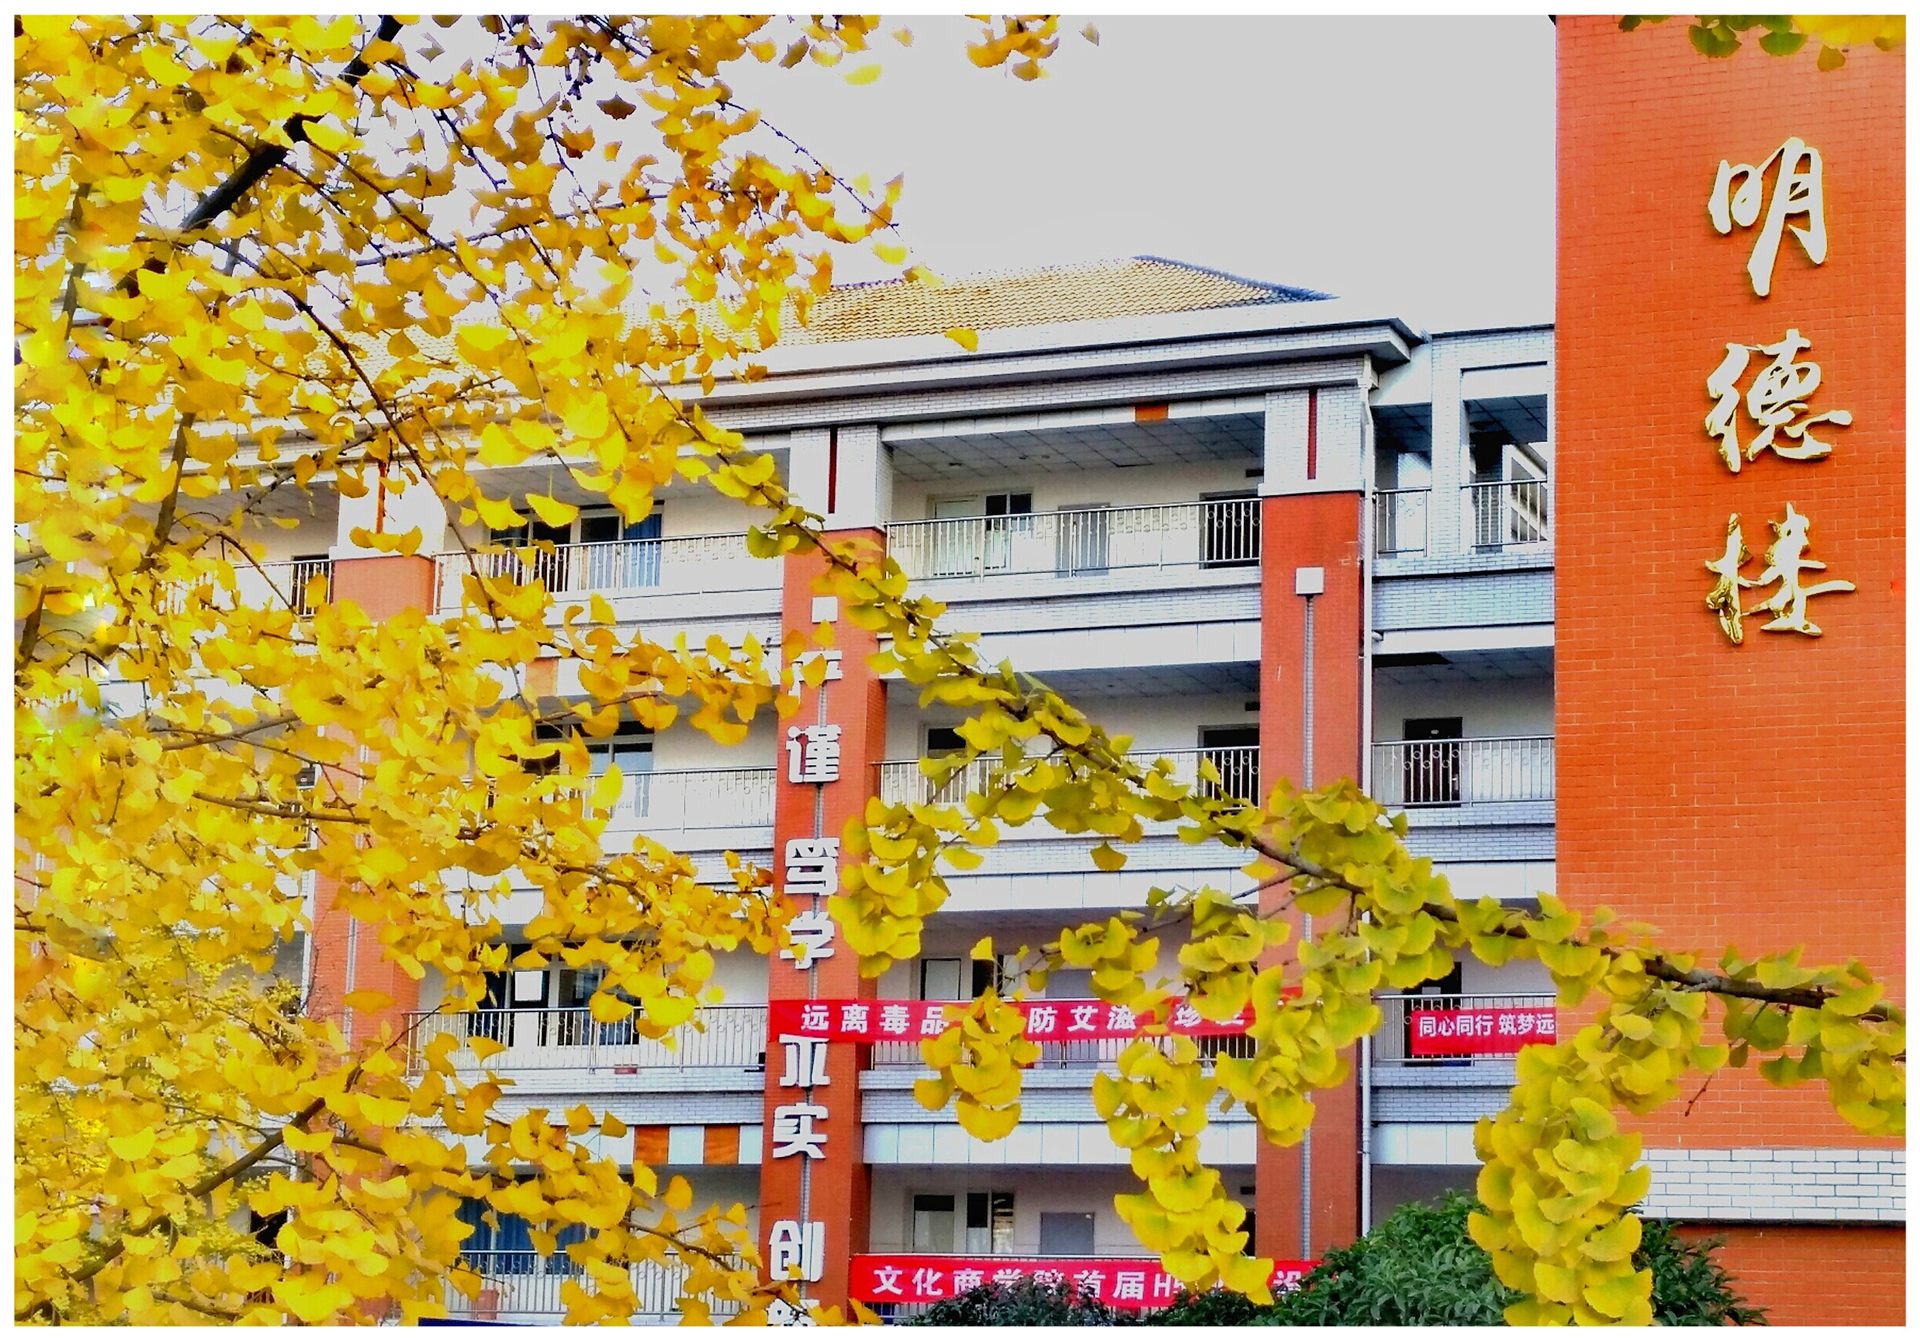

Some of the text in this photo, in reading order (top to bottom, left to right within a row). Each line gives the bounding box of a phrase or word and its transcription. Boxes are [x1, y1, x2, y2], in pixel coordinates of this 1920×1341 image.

[1704, 136, 1856, 645] 明德楼
[799, 1003, 949, 1035] 远离毒品
[1419, 1012, 1555, 1038] 同心同行 筑梦远
